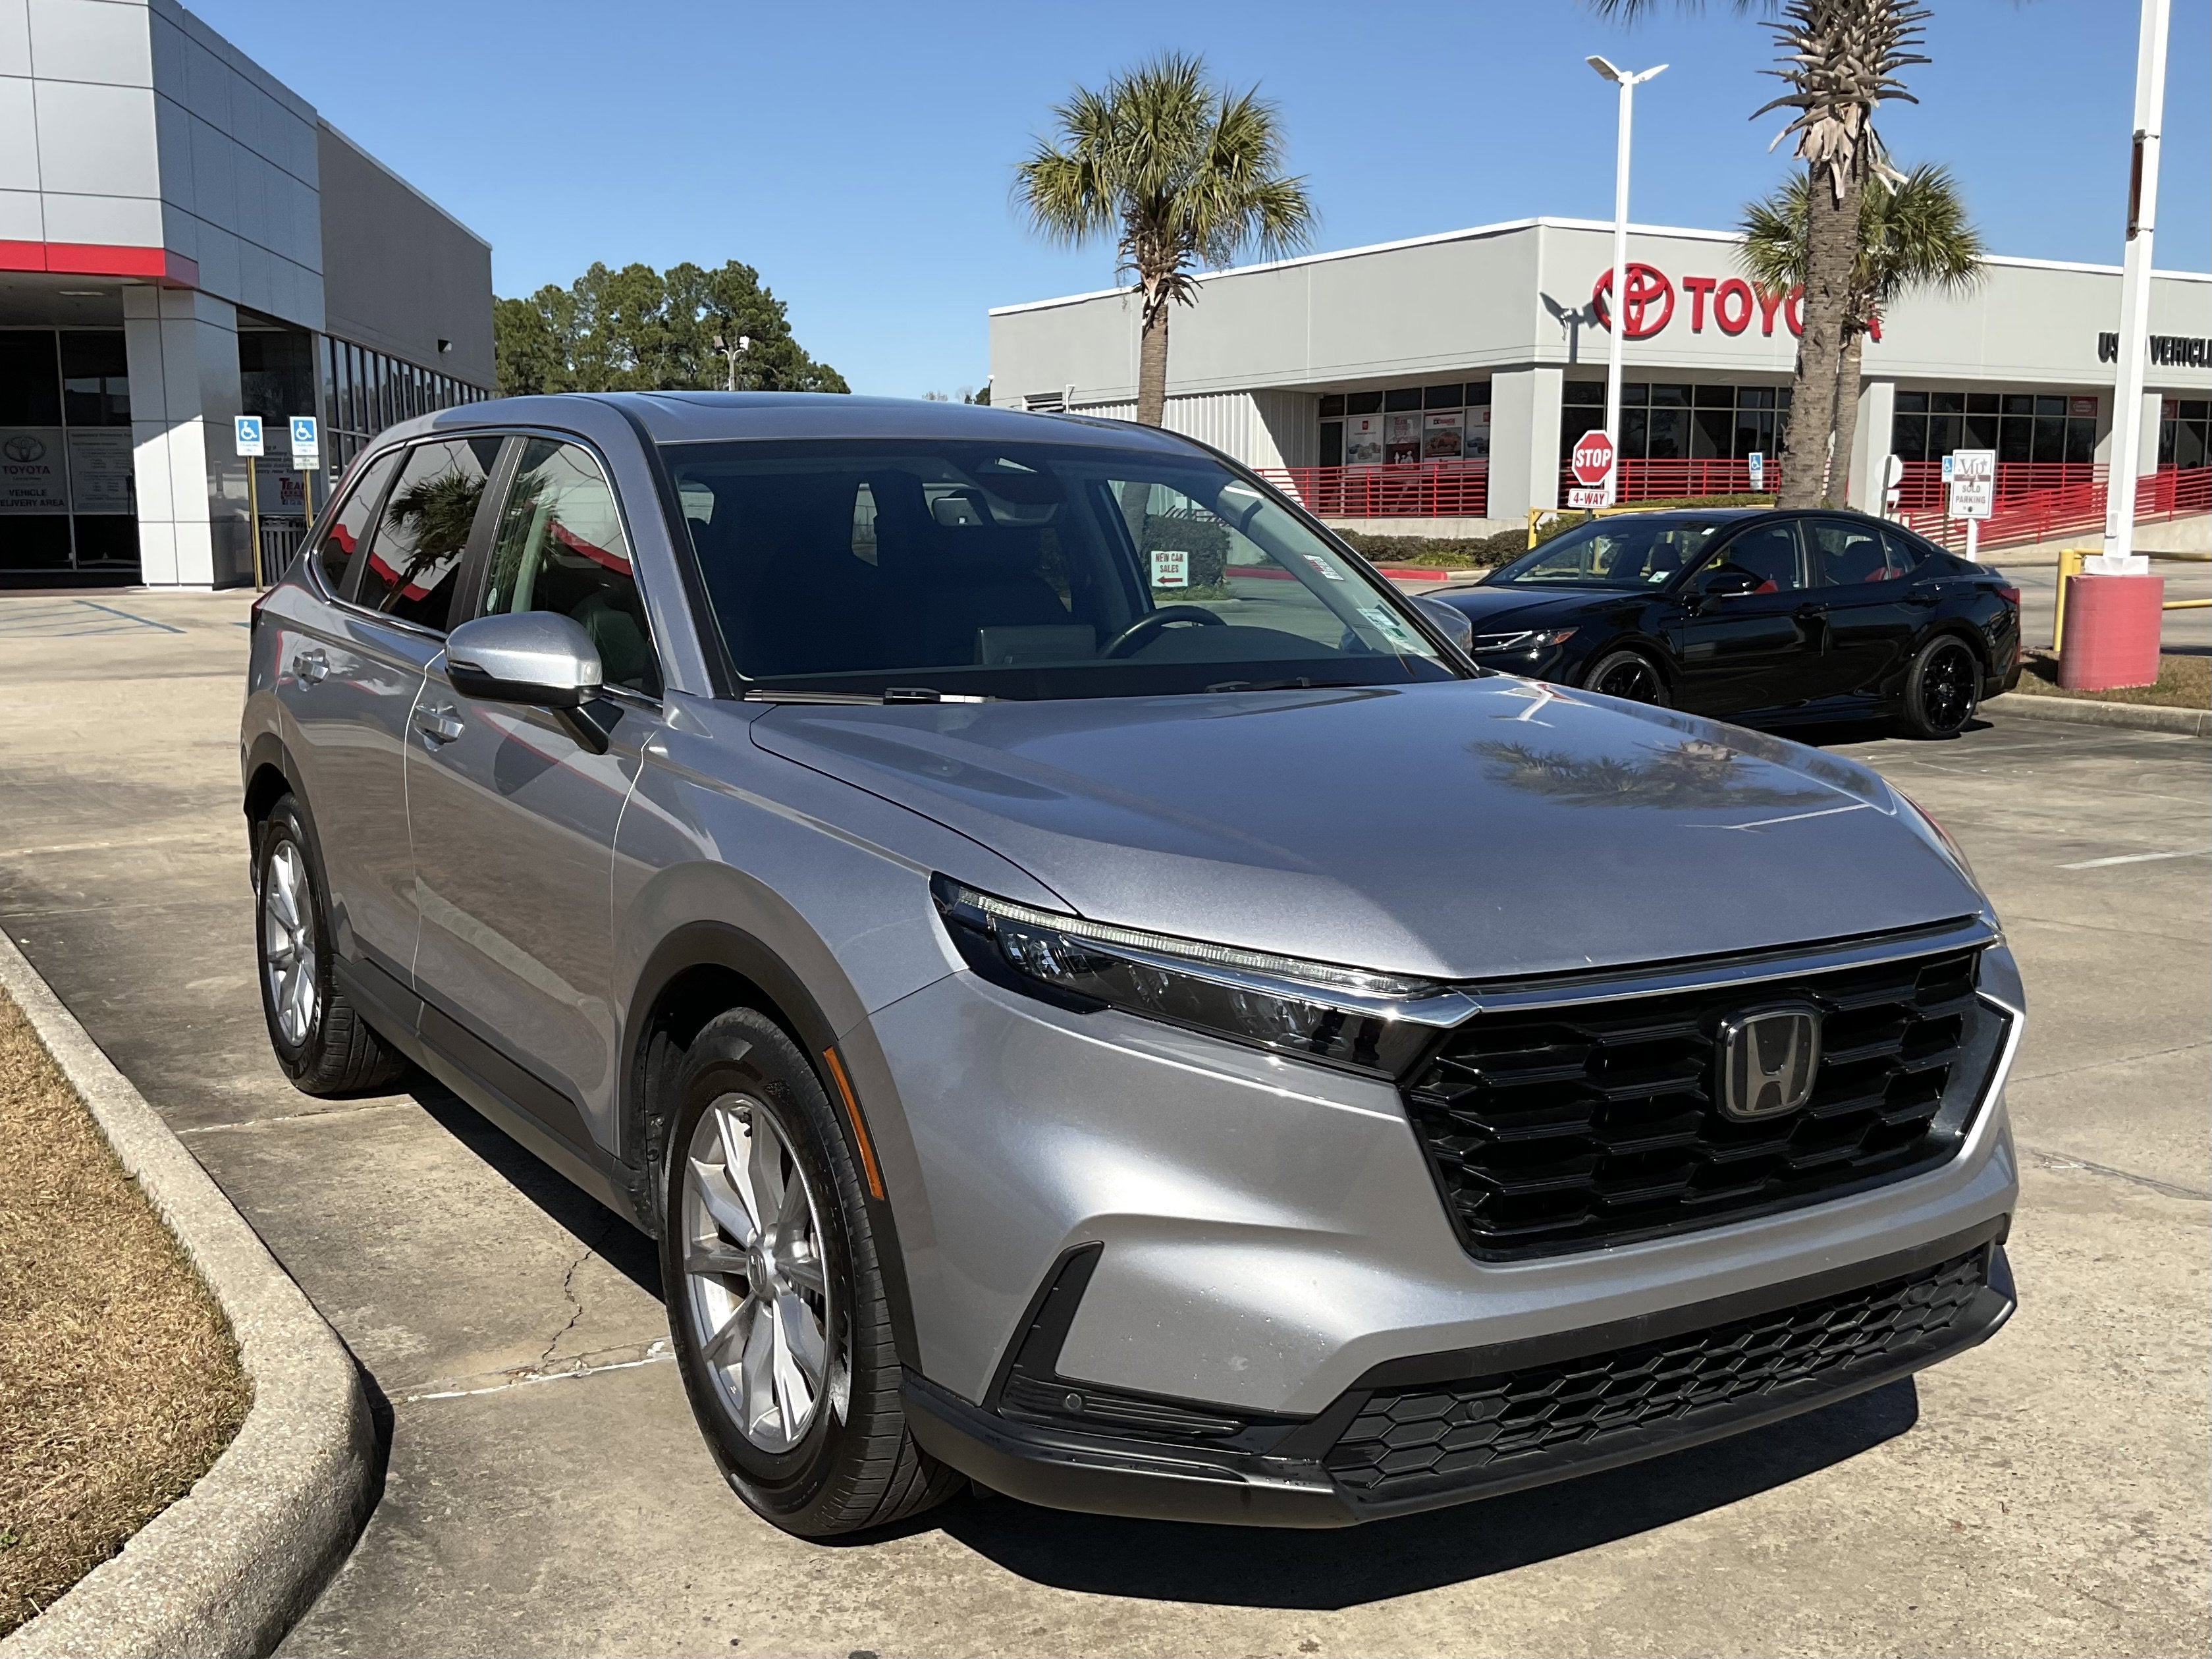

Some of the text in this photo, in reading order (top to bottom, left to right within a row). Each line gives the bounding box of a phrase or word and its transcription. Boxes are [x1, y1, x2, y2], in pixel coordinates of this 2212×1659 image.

[1683, 276, 1881, 343] TOY
[1575, 449, 1611, 468] STOP
[3, 465, 51, 475] TOYOTA
[1573, 492, 1605, 505] 4-WAY
[1955, 495, 1985, 504] PARKING
[1156, 553, 1183, 562] NEW CAR
[1160, 564, 1179, 573] SALES
